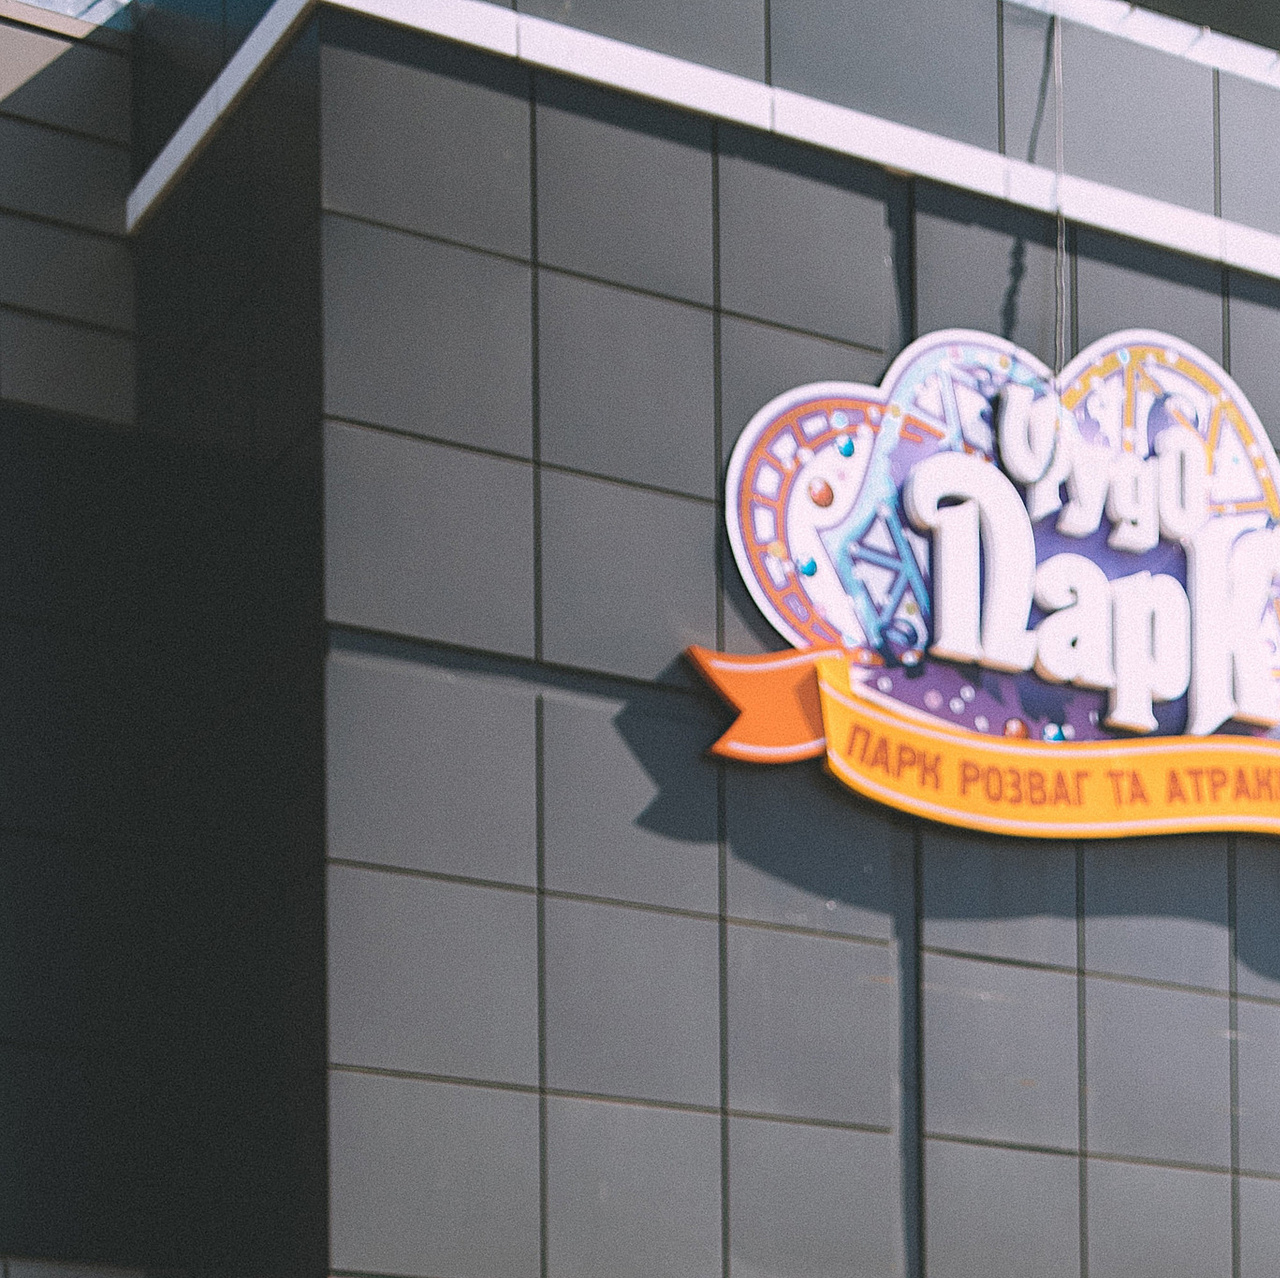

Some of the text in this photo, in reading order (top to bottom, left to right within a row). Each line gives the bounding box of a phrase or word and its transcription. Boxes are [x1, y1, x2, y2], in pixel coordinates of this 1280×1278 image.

[845, 723, 942, 790] ПАРК
[958, 762, 1090, 808] РОЗВАГ
[1108, 770, 1149, 808] ТА
